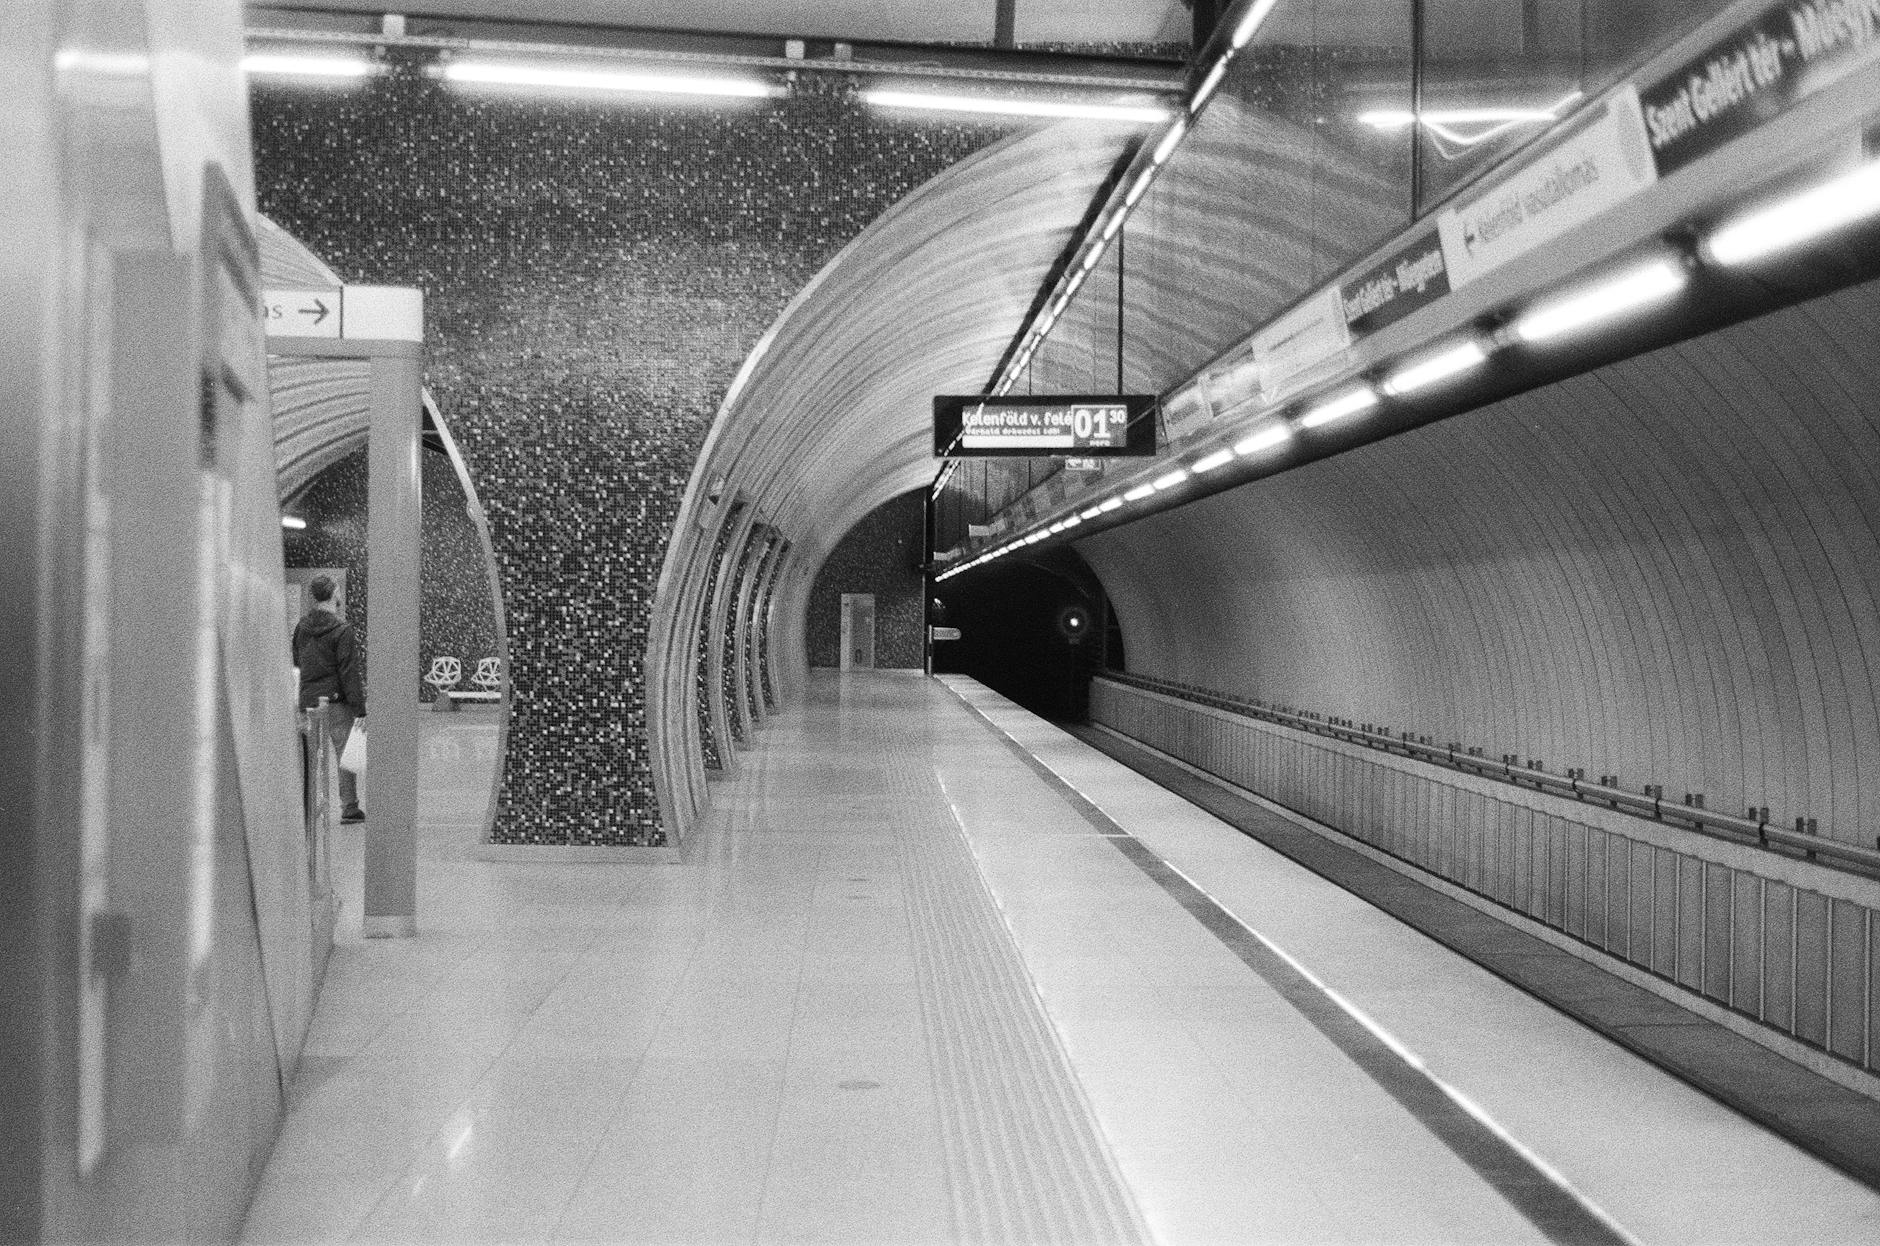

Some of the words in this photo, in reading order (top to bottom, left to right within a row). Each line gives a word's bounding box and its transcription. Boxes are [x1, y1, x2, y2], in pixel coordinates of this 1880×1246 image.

[1646, 87, 1697, 148] Szent
[1688, 50, 1755, 124] Gellért
[1749, 32, 1782, 88] tér
[962, 410, 1028, 426] Kelenföld
[1030, 413, 1042, 426] v.
[1074, 409, 1111, 438] 01
[1109, 410, 1126, 424] 30
